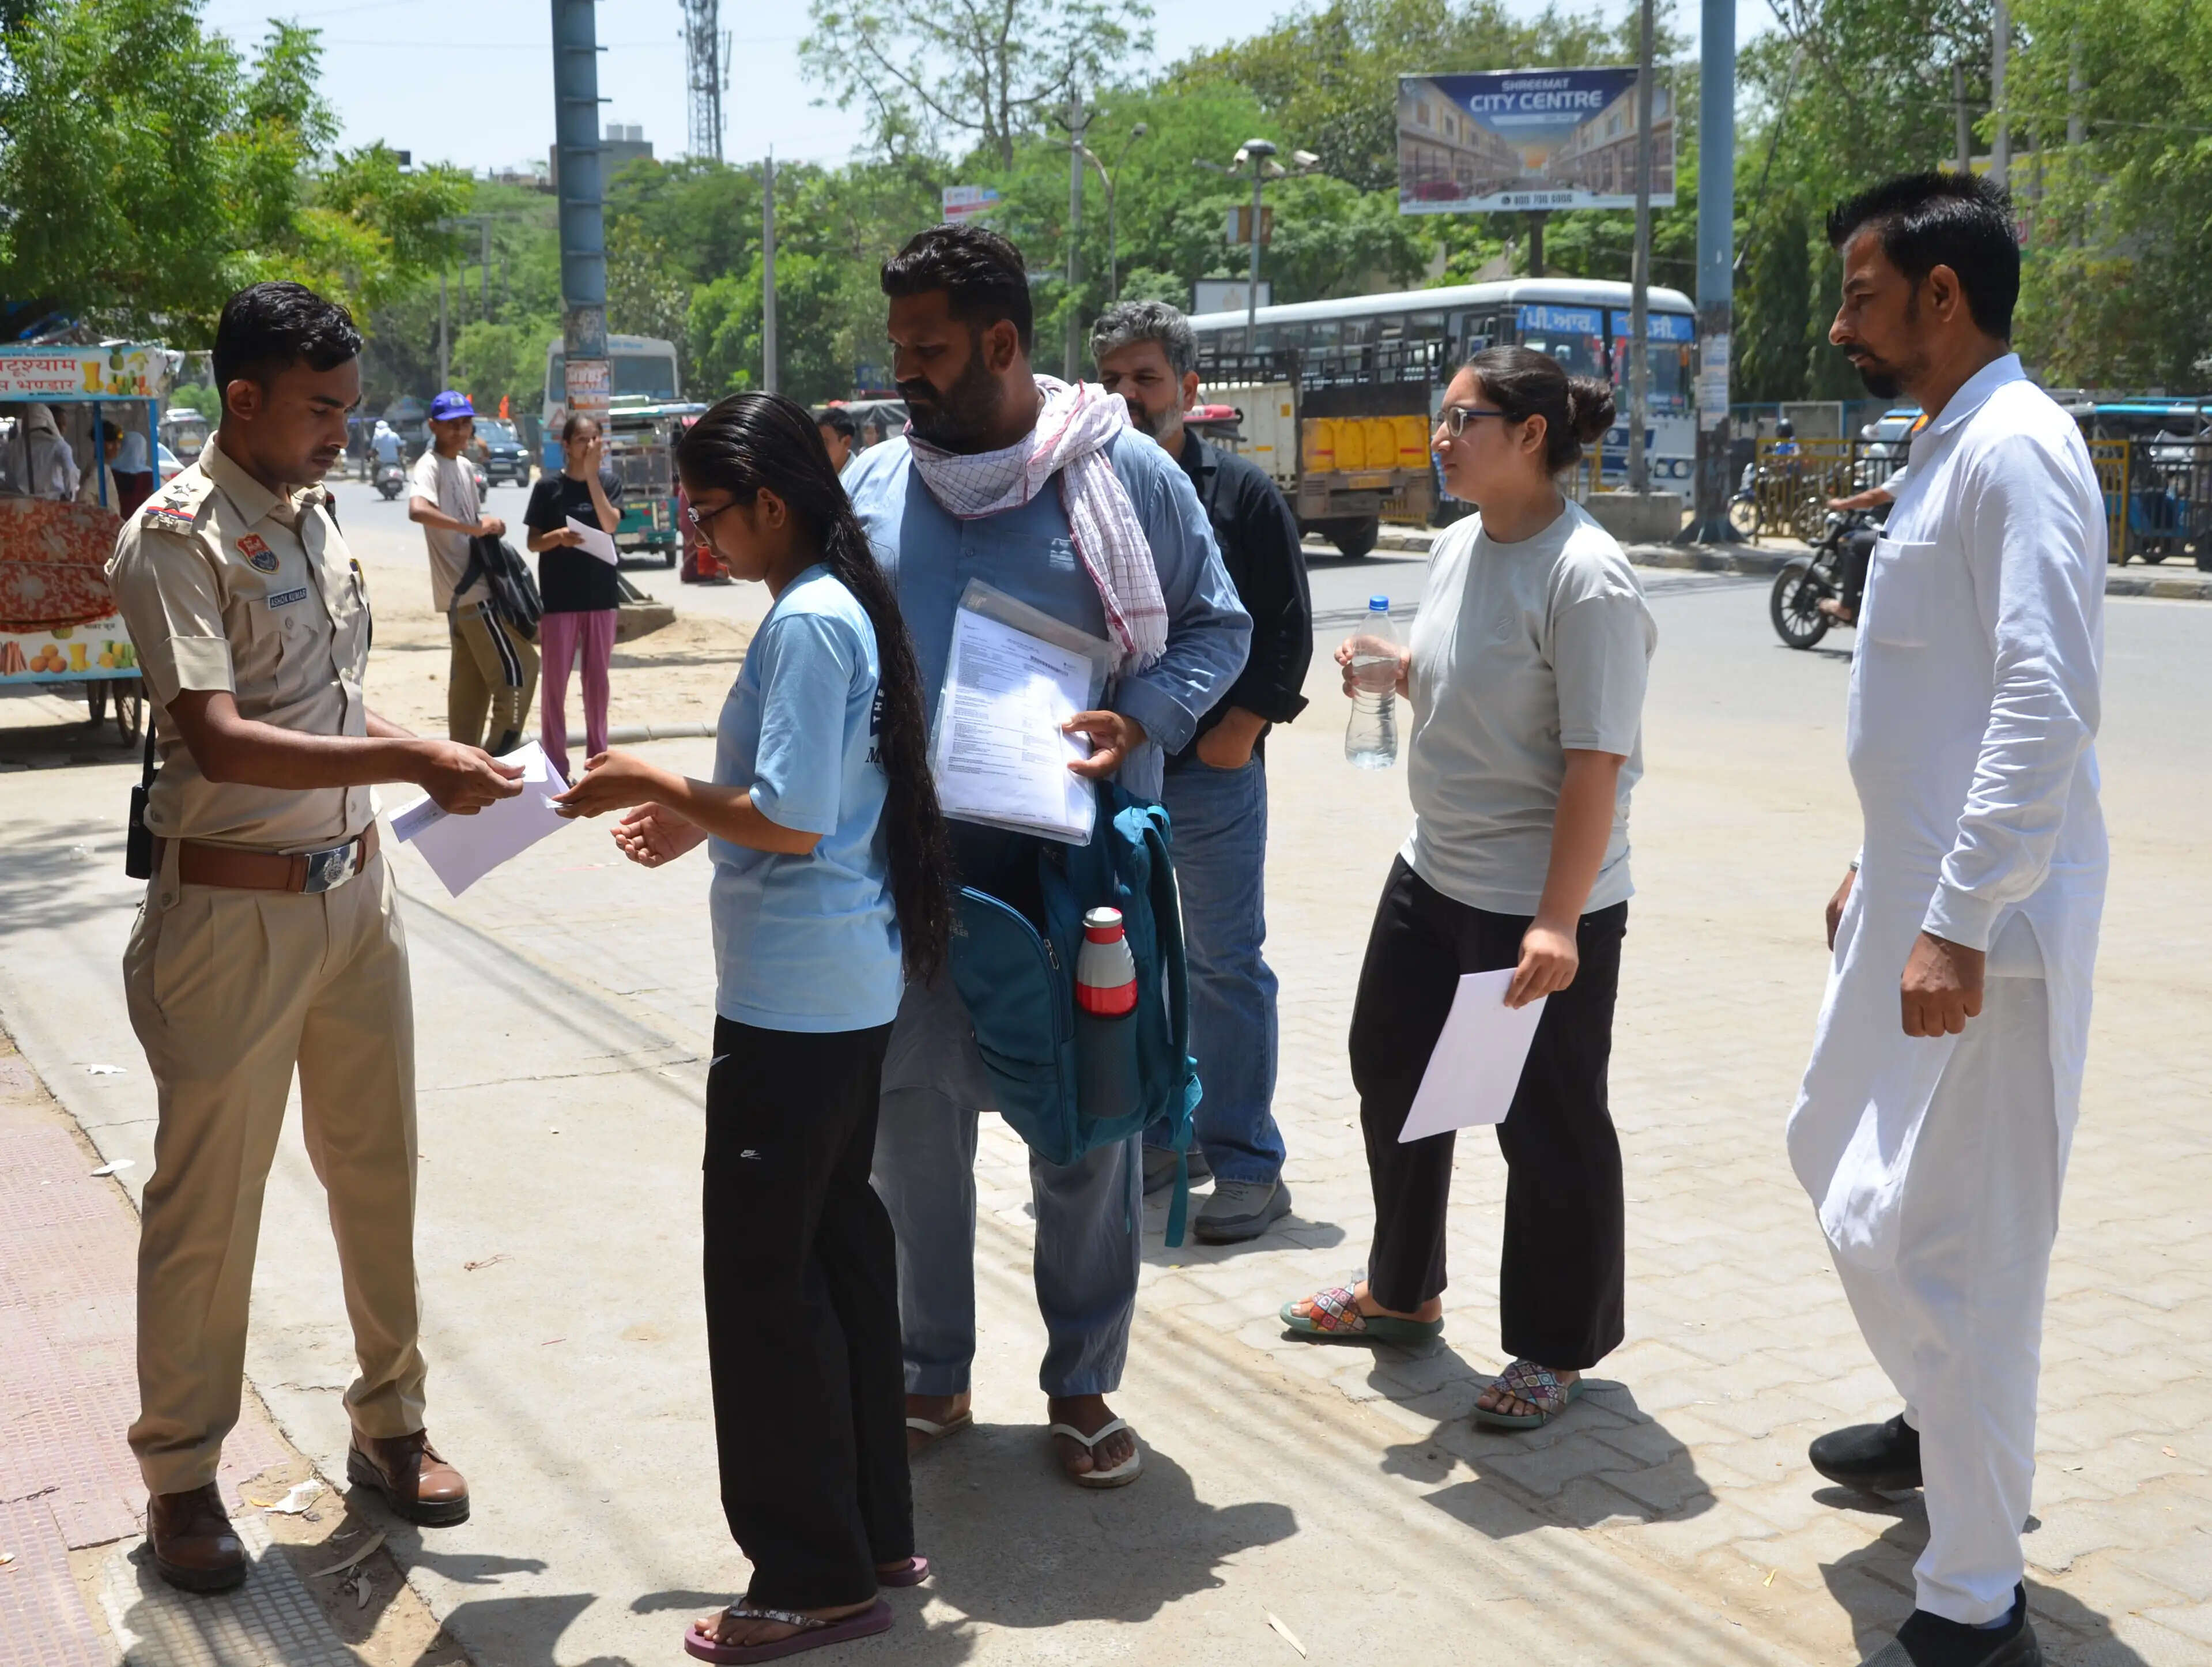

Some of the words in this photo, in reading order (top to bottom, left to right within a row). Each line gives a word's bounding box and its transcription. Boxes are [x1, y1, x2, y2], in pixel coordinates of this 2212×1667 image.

[1470, 93, 1515, 112] CITY
[1519, 90, 1602, 110] CENTRE
[271, 593, 288, 606] ASHOK
[289, 589, 305, 601] KUMAR
[873, 688, 885, 723] THE
